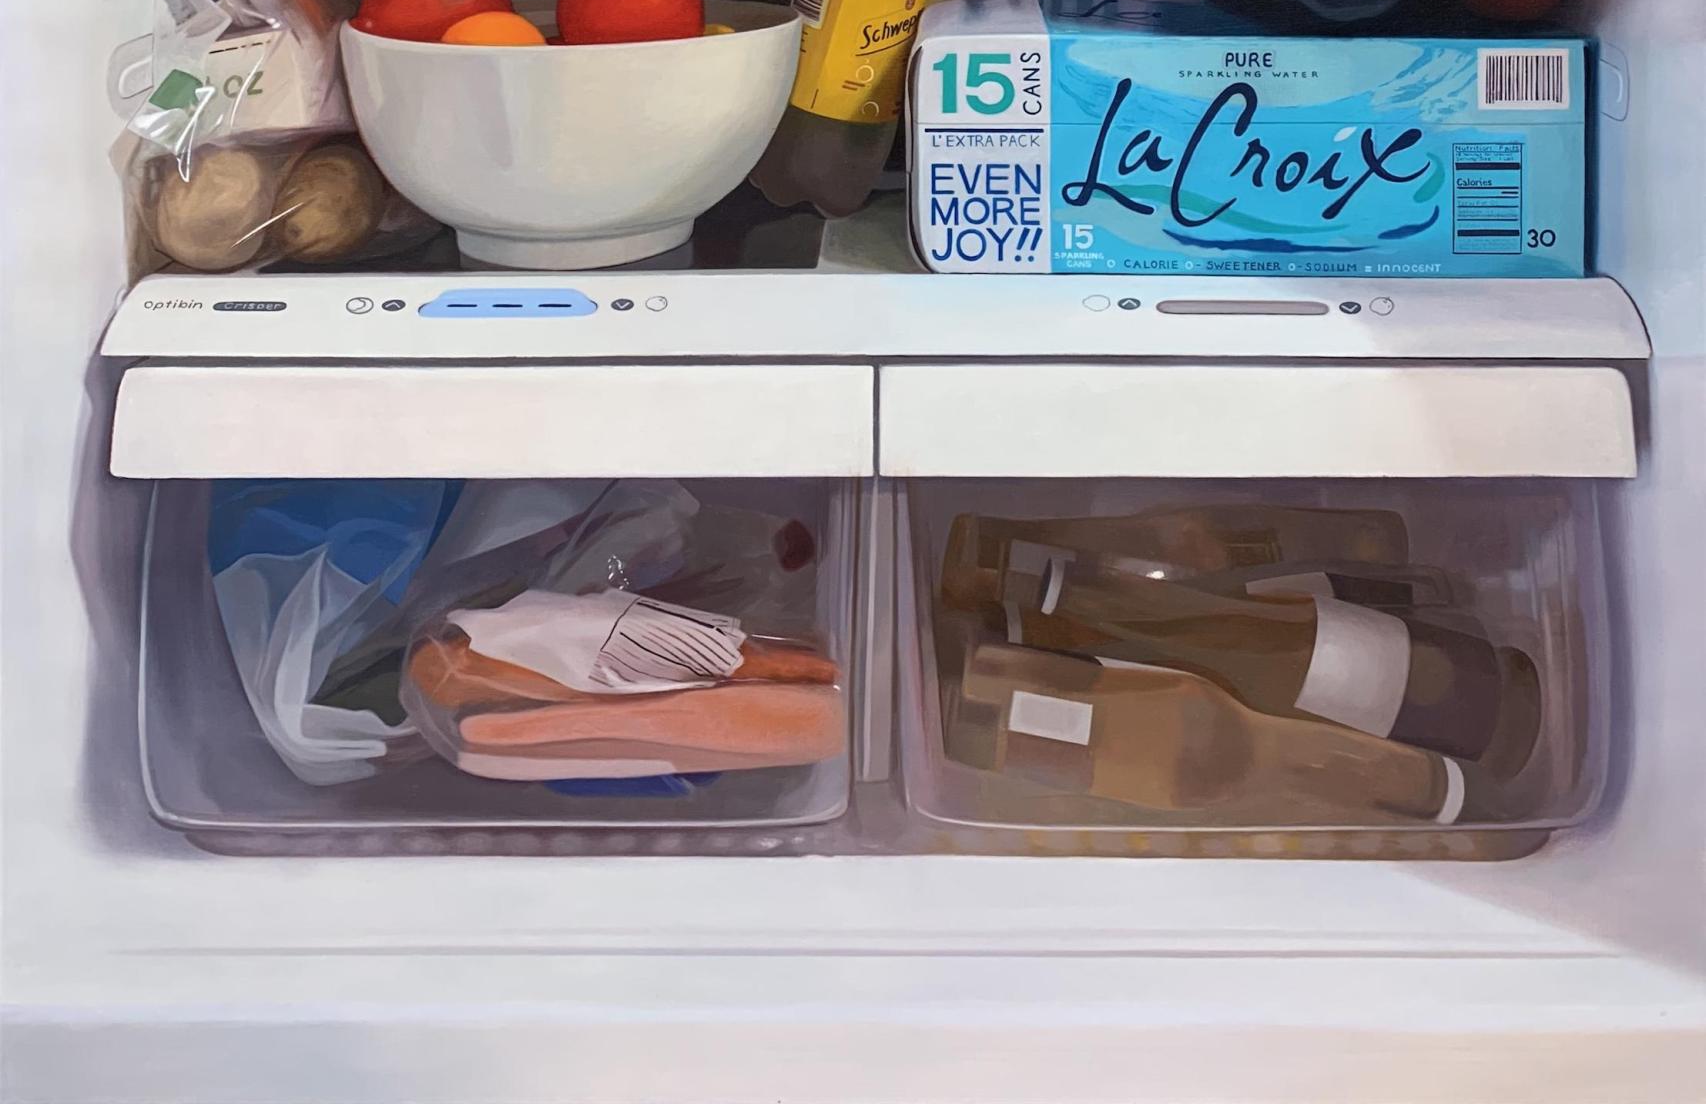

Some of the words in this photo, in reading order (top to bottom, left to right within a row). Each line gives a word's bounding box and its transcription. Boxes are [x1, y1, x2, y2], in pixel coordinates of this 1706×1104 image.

[1225, 52, 1273, 68] PURE
[932, 52, 1016, 115] 15
[1020, 51, 1042, 116] CANS
[1178, 70, 1262, 78] SPARKLING
[1272, 71, 1319, 79] WATER
[932, 134, 994, 148] L'EXTRA
[1000, 134, 1041, 148] PACK
[931, 163, 1041, 196] EVEN
[1456, 177, 1493, 186] Calories
[931, 197, 1041, 226] MORE
[931, 227, 1043, 263] JOY!!
[1062, 223, 1094, 250] 15
[1526, 228, 1556, 249] 30
[1123, 259, 1179, 270] CALORIE
[1206, 260, 1281, 272] SWEETENER
[1304, 262, 1357, 273] SODIUM
[143, 300, 203, 311] Optibin
